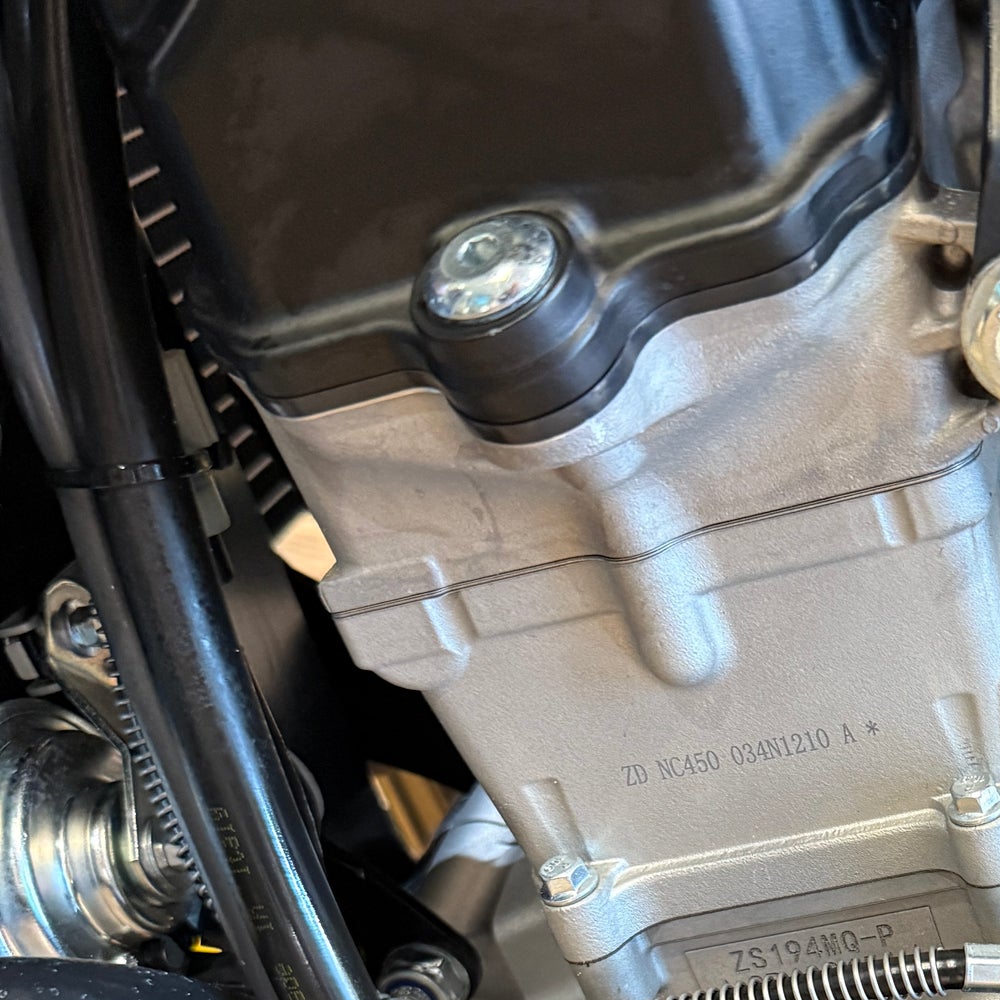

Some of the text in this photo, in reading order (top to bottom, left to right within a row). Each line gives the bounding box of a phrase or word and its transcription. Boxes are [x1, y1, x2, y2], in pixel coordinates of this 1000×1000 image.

[621, 764, 648, 786] ZD
[656, 749, 720, 780] NC450
[730, 728, 830, 766] 034N1210
[842, 722, 857, 745] A
[729, 923, 894, 973] ZS194MQ-P
